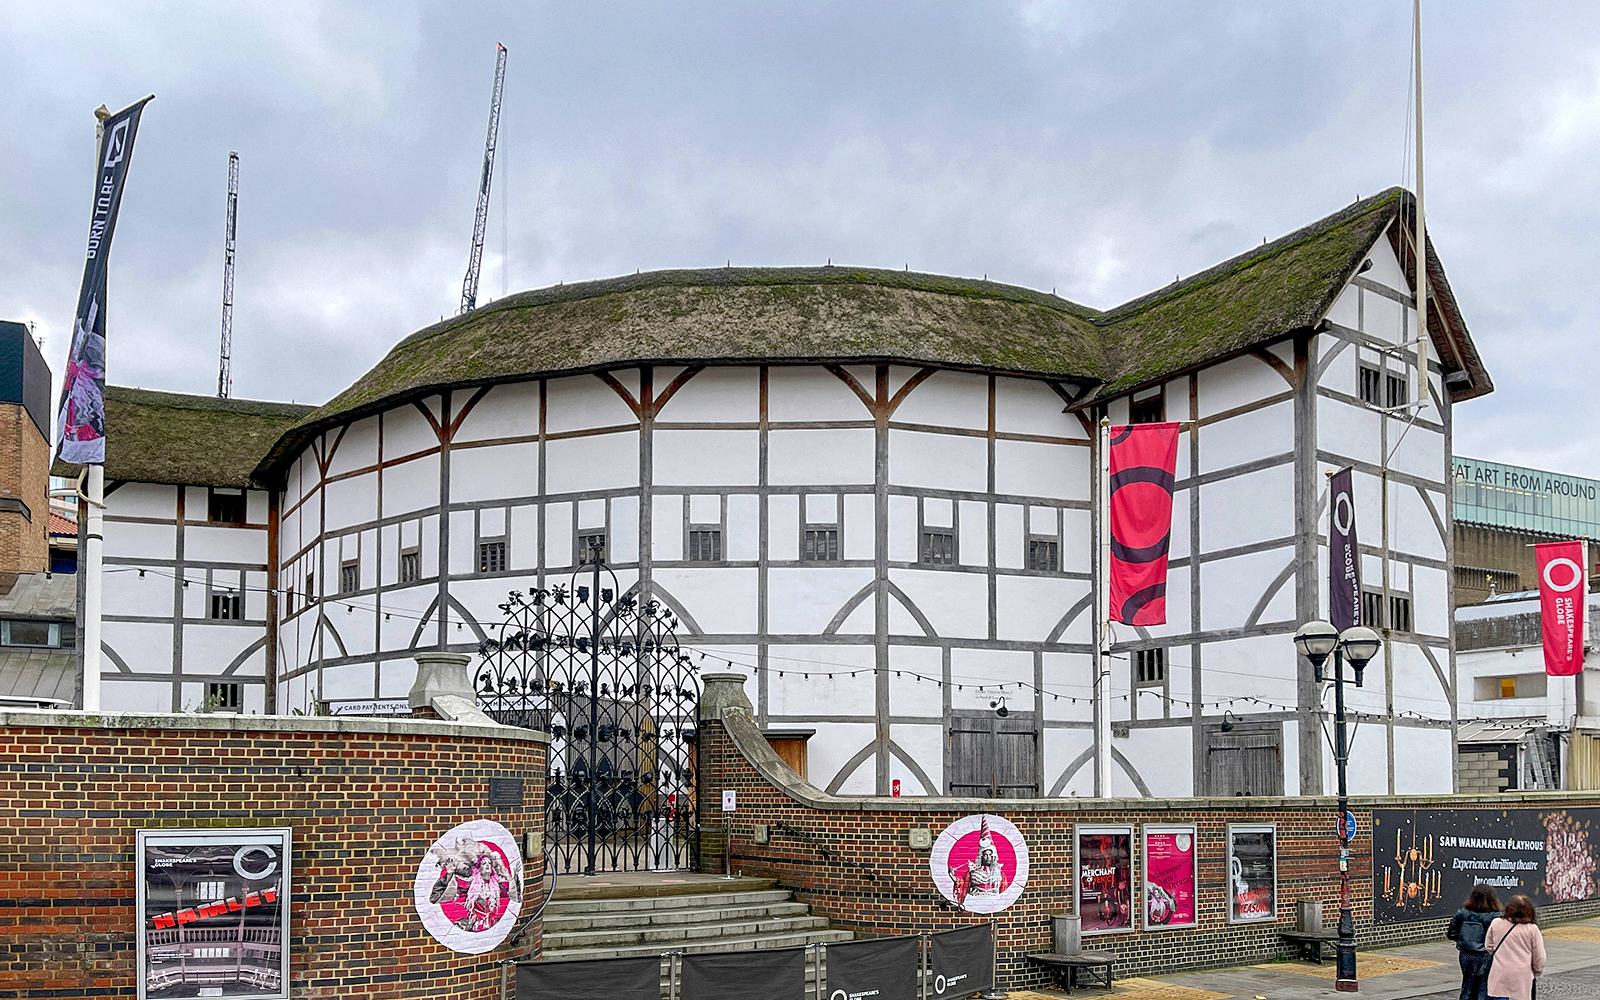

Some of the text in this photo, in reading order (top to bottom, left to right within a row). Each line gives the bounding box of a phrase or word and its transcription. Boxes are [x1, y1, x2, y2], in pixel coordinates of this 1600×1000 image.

[1475, 467, 1500, 485] ART
[1505, 471, 1541, 492] FROM
[1545, 479, 1596, 500] AROUND
[1555, 597, 1565, 625] GLOBE
[1564, 597, 1575, 661] SHAKESPEARE'S
[1440, 836, 1546, 851] SAM WANAMAKER PLAYHOUS
[1081, 867, 1116, 878] MERCHANT
[1452, 857, 1539, 873] Experience thrilling theatre
[1168, 876, 1190, 890] Dream
[1484, 875, 1519, 890] candlelight
[151, 886, 278, 931] HAMLET
